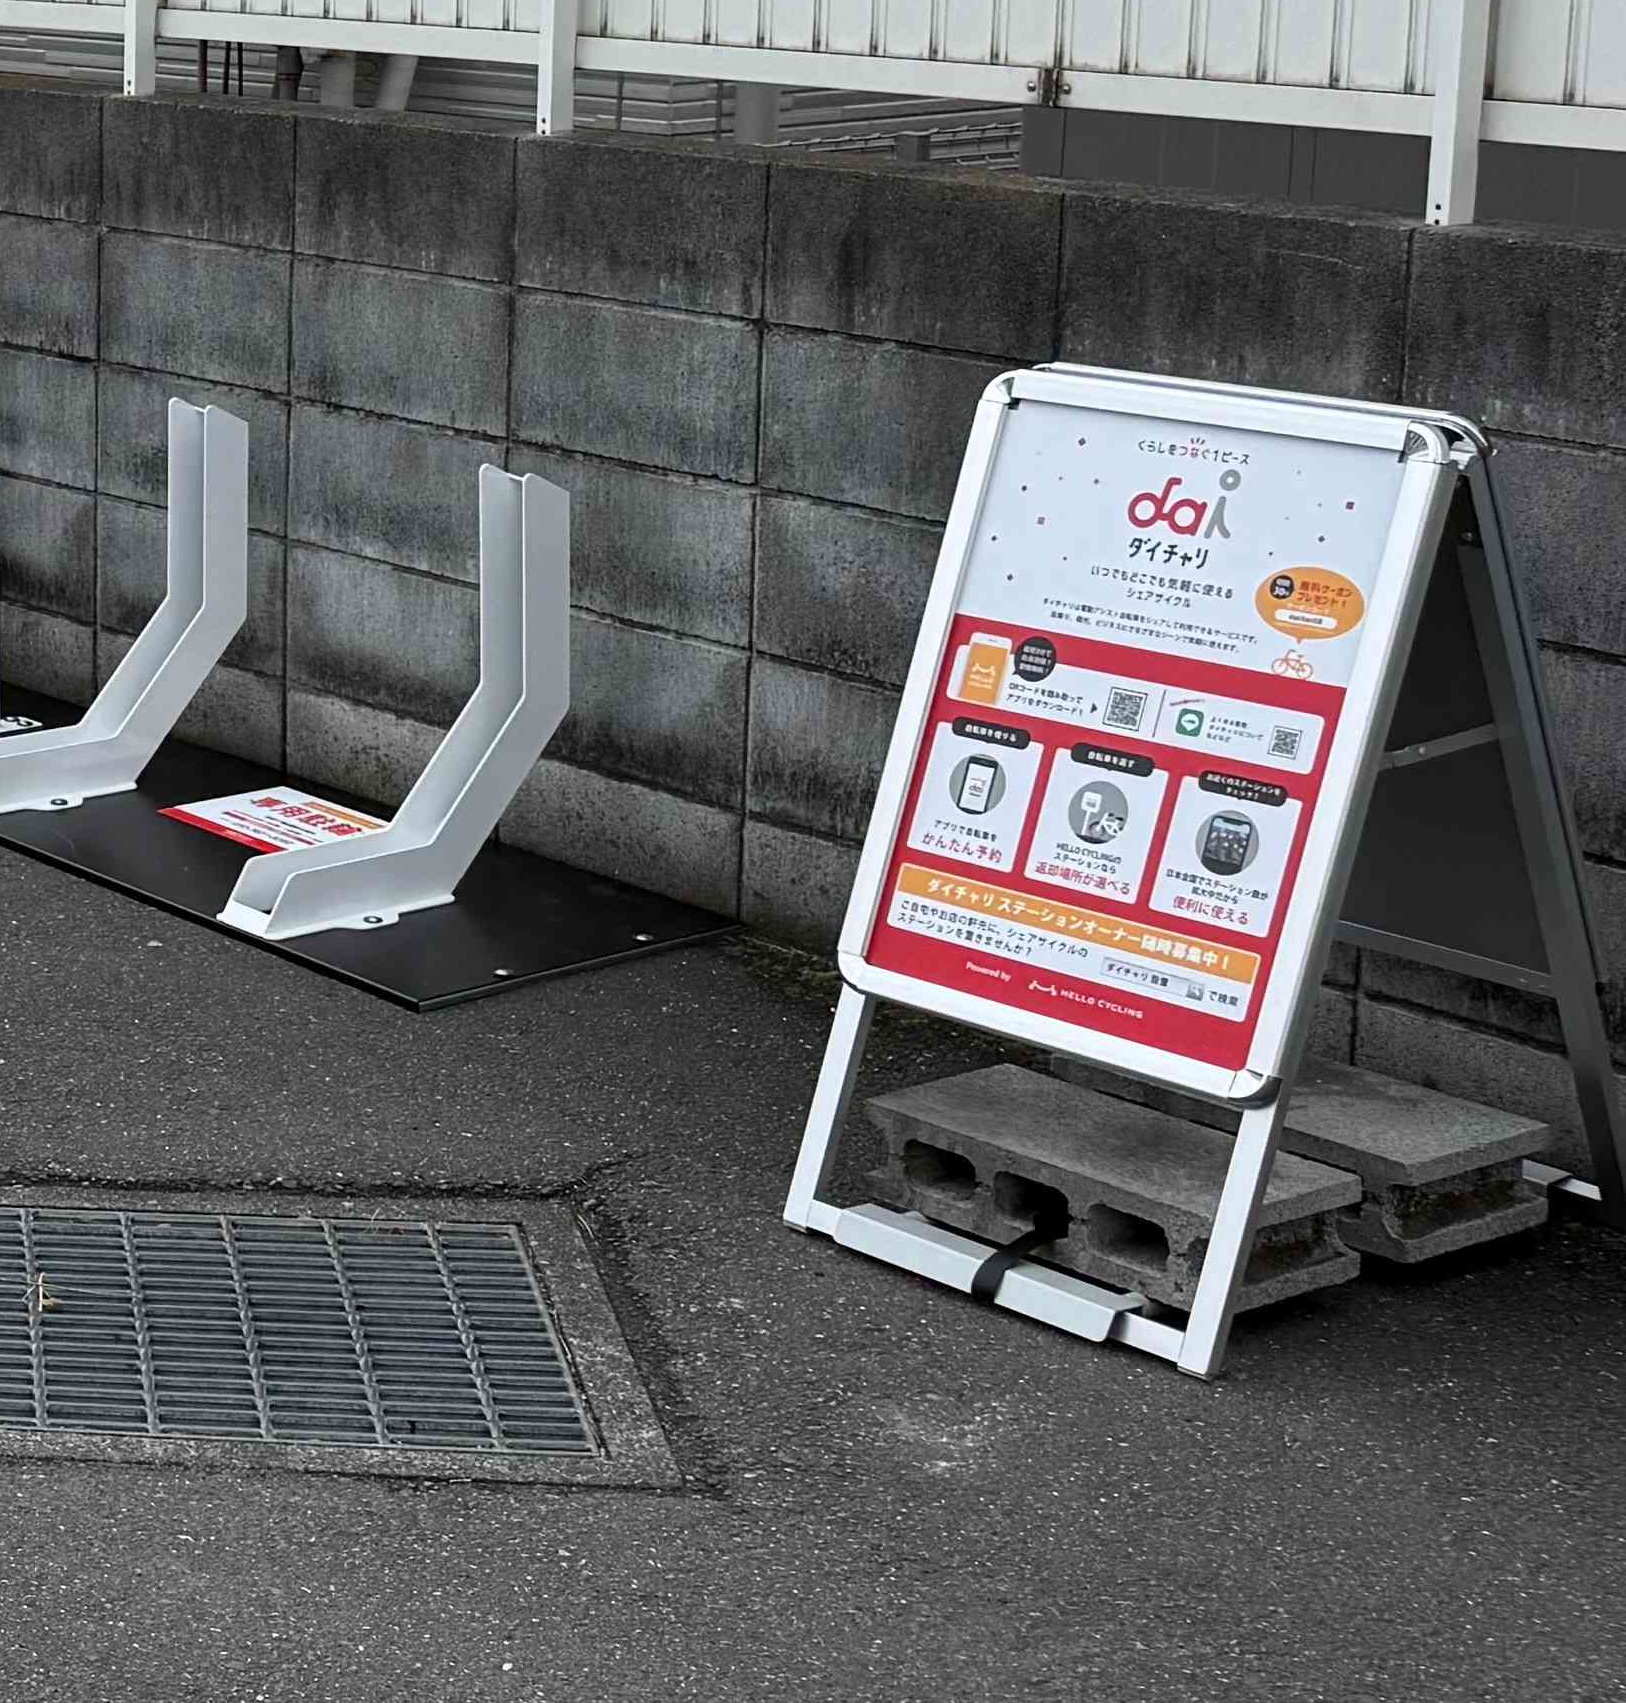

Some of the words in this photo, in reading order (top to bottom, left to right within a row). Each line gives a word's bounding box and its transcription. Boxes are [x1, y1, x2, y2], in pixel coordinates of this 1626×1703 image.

[1128, 538, 1210, 569] ダイチャリ
[1090, 566, 1234, 600] いつでもどこでも気軽に使える
[921, 832, 1004, 864] かんたん予約
[927, 877, 995, 909] ダイチャリ
[1173, 896, 1249, 925] 便利に使える
[1060, 988, 1096, 1007] HELLO
[1097, 999, 1144, 1020] CYCLING
